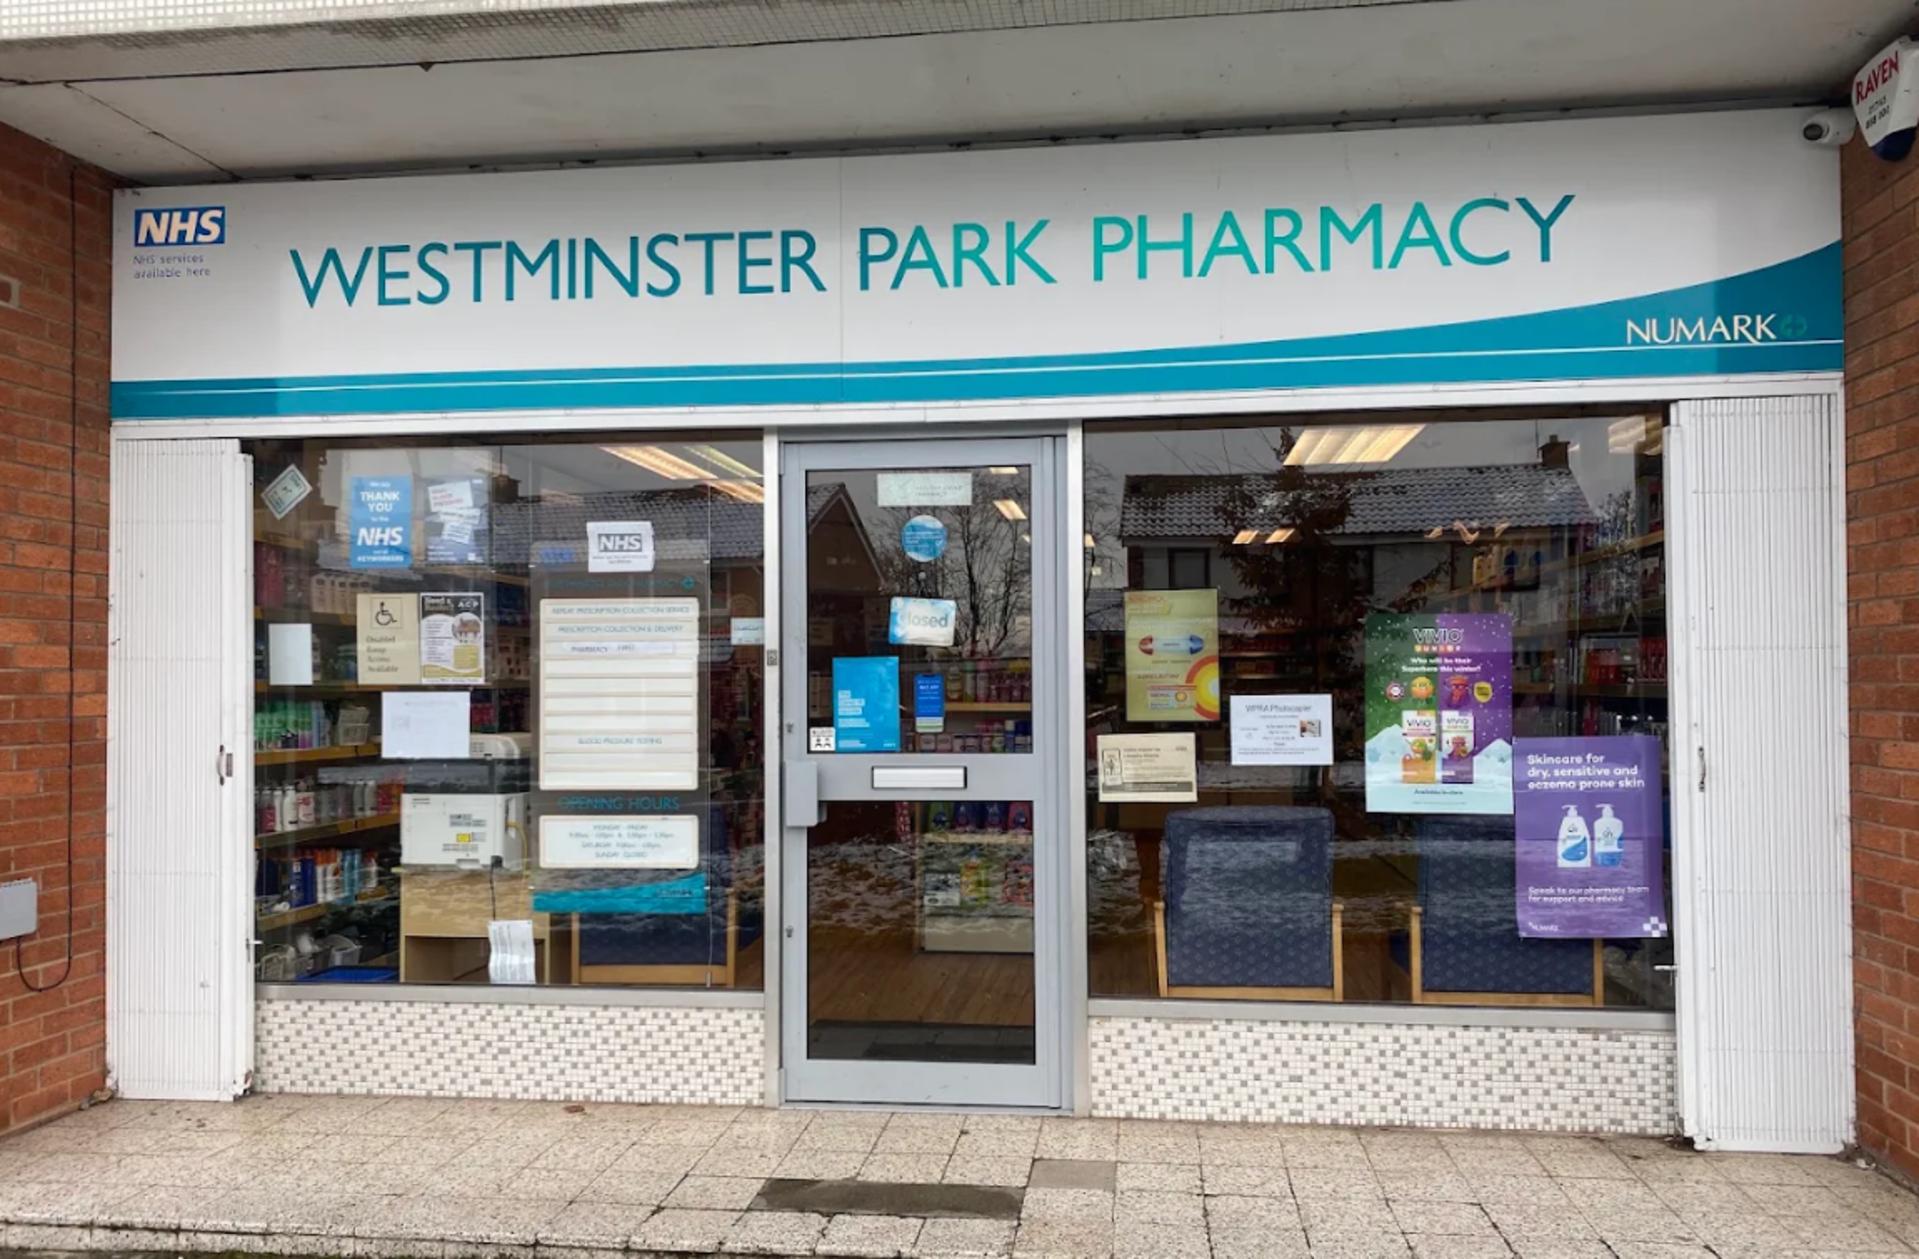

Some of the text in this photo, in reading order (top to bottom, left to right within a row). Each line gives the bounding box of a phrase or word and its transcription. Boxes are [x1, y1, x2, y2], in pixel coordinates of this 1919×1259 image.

[1855, 49, 1900, 106] RAVEN
[137, 209, 223, 244] NHS
[289, 194, 1576, 308] WESTMINSTER PARK PHARMACY
[132, 254, 204, 264] NHS services
[134, 267, 211, 279] available here
[1625, 313, 1777, 345] NUMARK
[360, 490, 400, 501] THANK
[367, 502, 393, 512] YOU
[356, 526, 405, 546] NHS
[599, 535, 642, 551] NHS
[576, 606, 620, 614] PRESCRIPTION
[622, 606, 665, 614] COLLECTION
[666, 605, 690, 613] SERVICE
[558, 625, 601, 633] PRESCRIPTION
[603, 625, 646, 633] COLLECTION
[654, 625, 683, 633] DELIVERY
[1412, 627, 1464, 644] VIVIO
[1526, 752, 1605, 765] Skincare for
[1527, 764, 1639, 779] dry, sensitive and
[1527, 777, 1645, 791] eczema prone skin
[558, 796, 680, 810] OPENING HOURS
[1527, 886, 1555, 896] Speak
[1557, 886, 1567, 894] to
[1583, 886, 1625, 896] pharmacy
[1627, 885, 1650, 893] team
[1528, 894, 1541, 903] for
[1543, 895, 1577, 904] support
